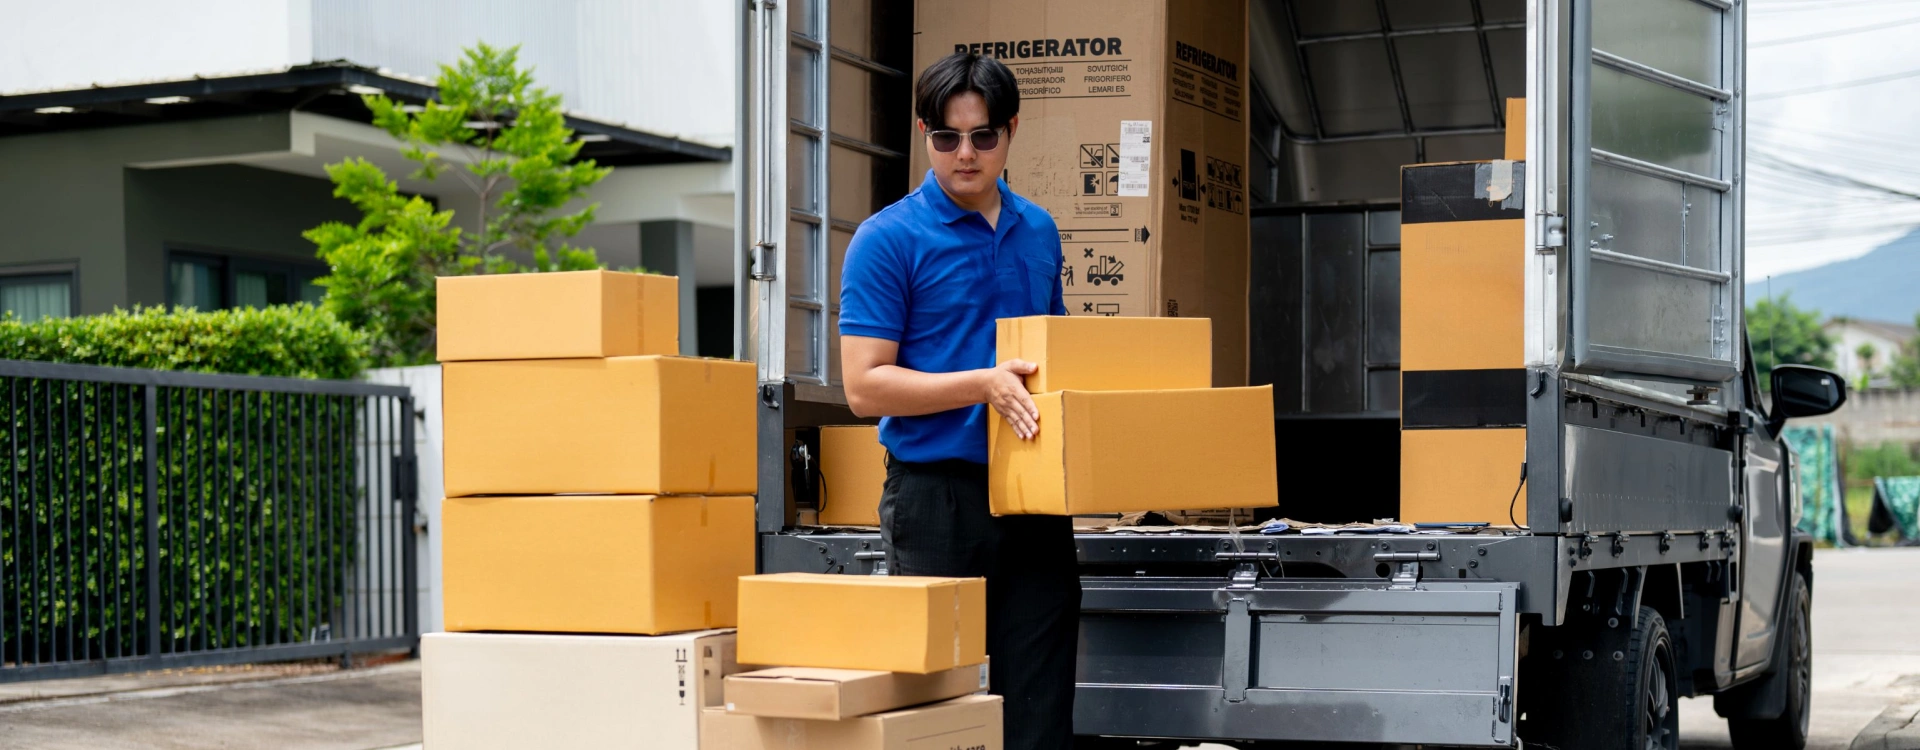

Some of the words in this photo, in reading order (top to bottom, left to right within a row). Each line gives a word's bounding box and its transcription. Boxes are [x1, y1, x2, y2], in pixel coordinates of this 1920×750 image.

[954, 37, 1122, 60] REFRIGERATOR
[1175, 40, 1237, 82] REFRIGERATOR
[1086, 64, 1129, 73] SOVUTGICH
[1017, 76, 1066, 86] EFRIGERADOR
[1083, 74, 1132, 84] FRIGORIFERO
[1088, 85, 1114, 94] LEMARI
[1115, 85, 1125, 93] ES
